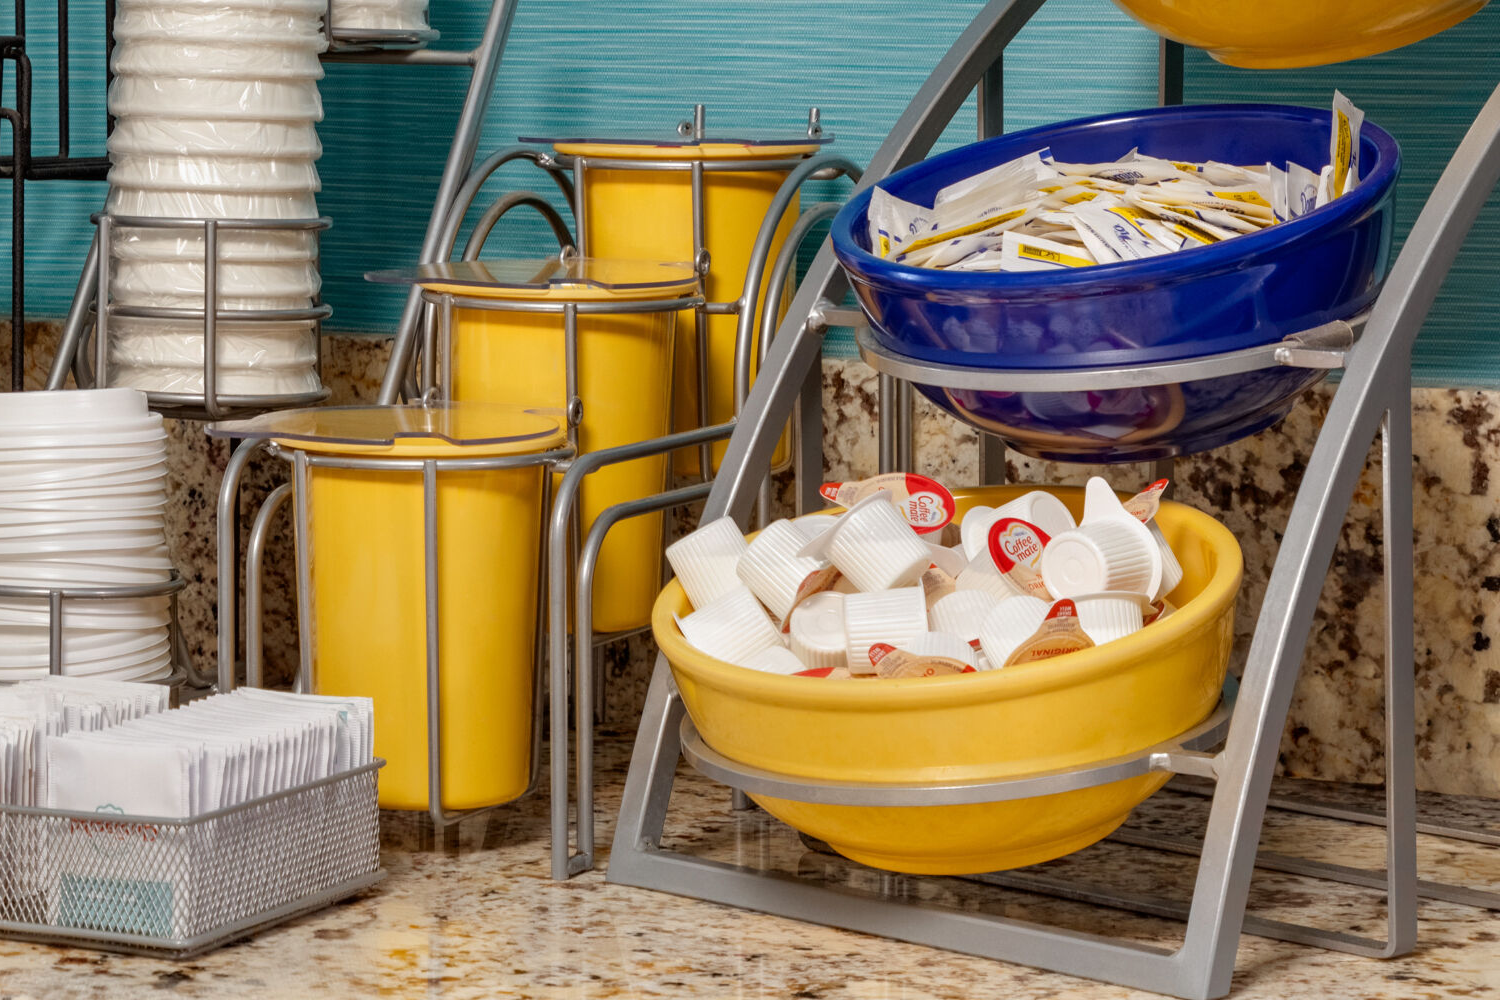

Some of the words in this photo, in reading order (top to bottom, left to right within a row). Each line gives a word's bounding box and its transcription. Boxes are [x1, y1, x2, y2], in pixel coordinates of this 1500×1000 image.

[908, 500, 919, 522] mate
[917, 495, 934, 522] Coffee
[1004, 535, 1033, 556] Coffee
[1016, 543, 1039, 562] mate
